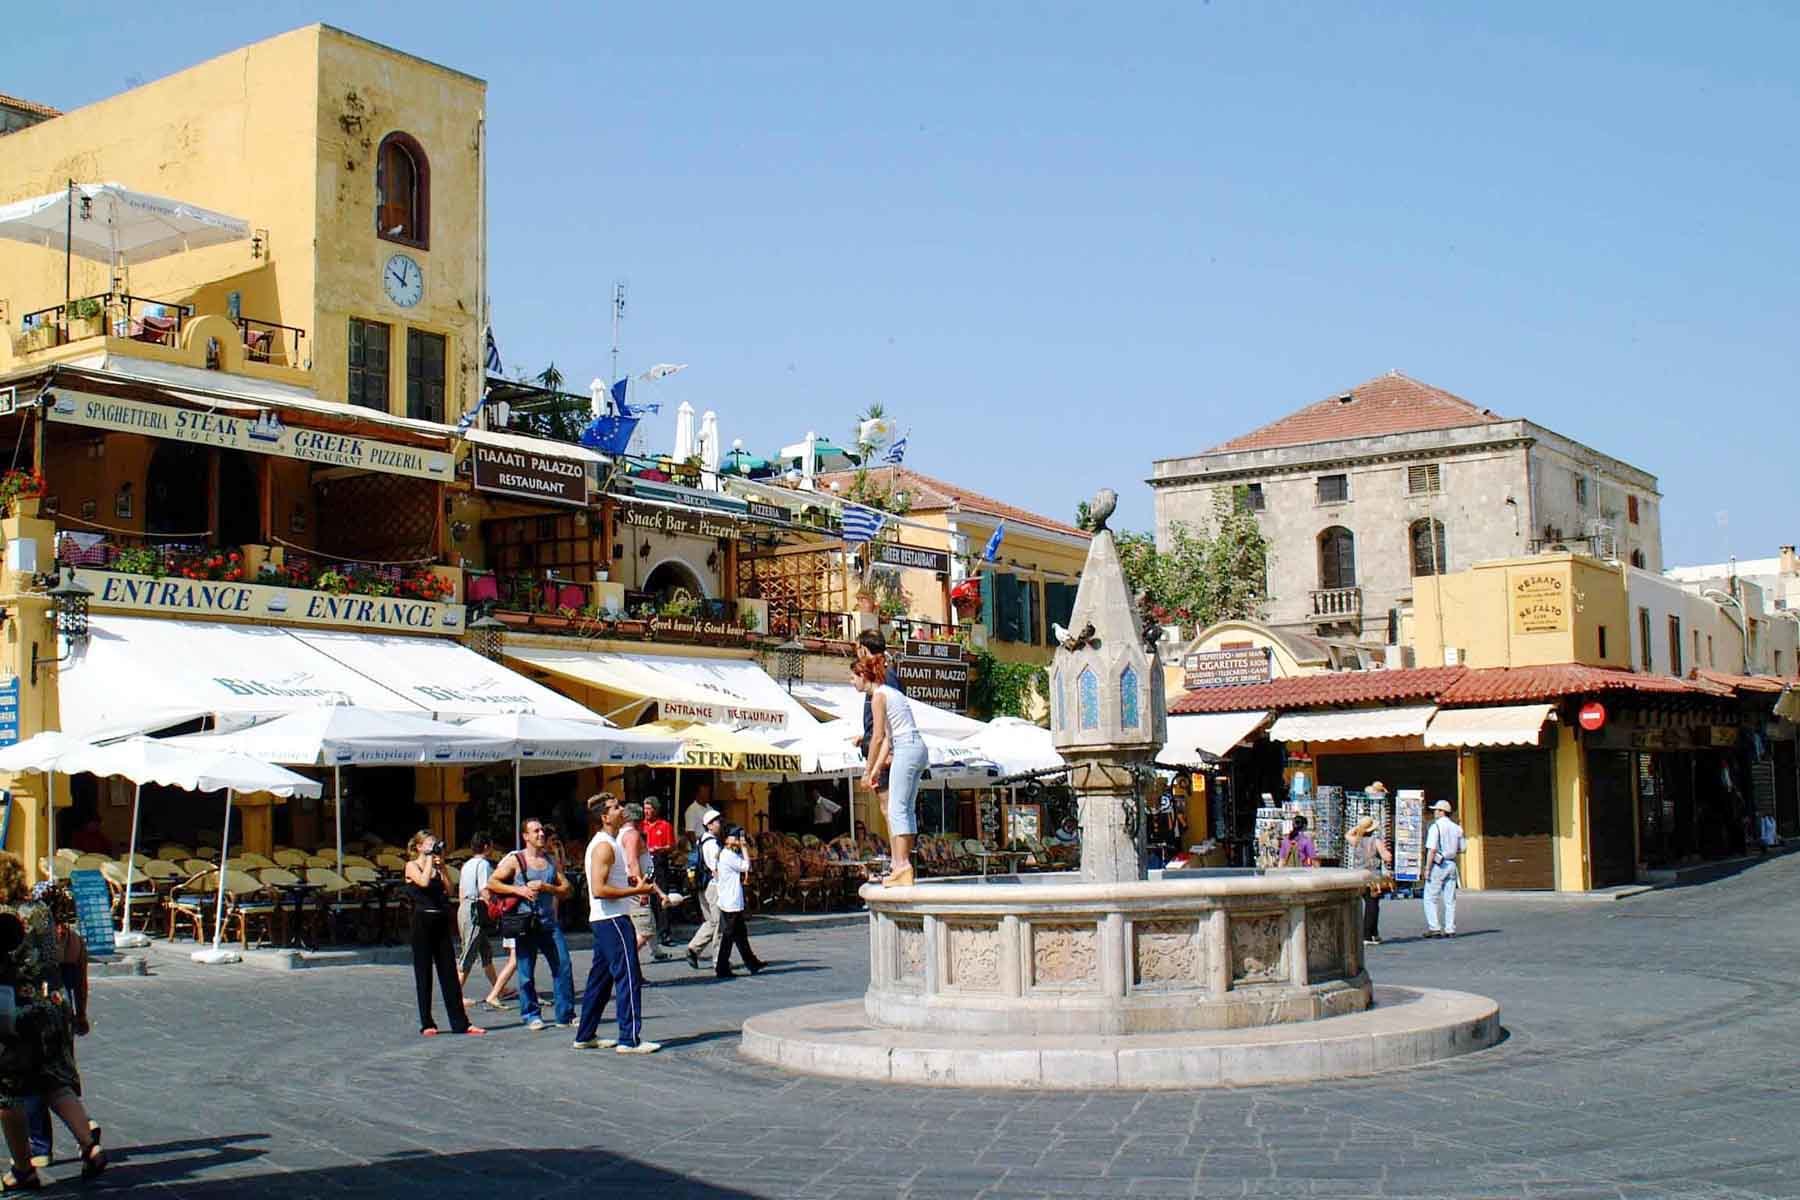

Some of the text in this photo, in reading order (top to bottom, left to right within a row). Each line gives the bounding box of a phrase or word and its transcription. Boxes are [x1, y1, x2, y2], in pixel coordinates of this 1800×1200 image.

[86, 401, 168, 430] SPAGHETTERIA
[175, 410, 240, 435] STEAK
[176, 429, 239, 446] HOUSE
[294, 430, 366, 455] GREEK
[294, 448, 364, 466] RESTAURANT
[369, 448, 424, 471] PIZZERIA
[531, 457, 583, 477] PALAZZO
[499, 473, 565, 493] RESTAURANT
[751, 503, 780, 518] PIZZERIA
[626, 510, 663, 528] Snack
[665, 513, 688, 531] Bar
[699, 521, 740, 540] Pizzeria
[900, 549, 937, 568] RESTAURANT
[101, 577, 437, 627] ENTRANCE ENTRANCE
[1199, 659, 1249, 671] CIGARETTES
[935, 669, 967, 681] PALAZZO
[906, 686, 961, 700] RESTAURANT
[664, 703, 713, 718] ENTRANCE
[746, 753, 801, 770] HOLSTEN
